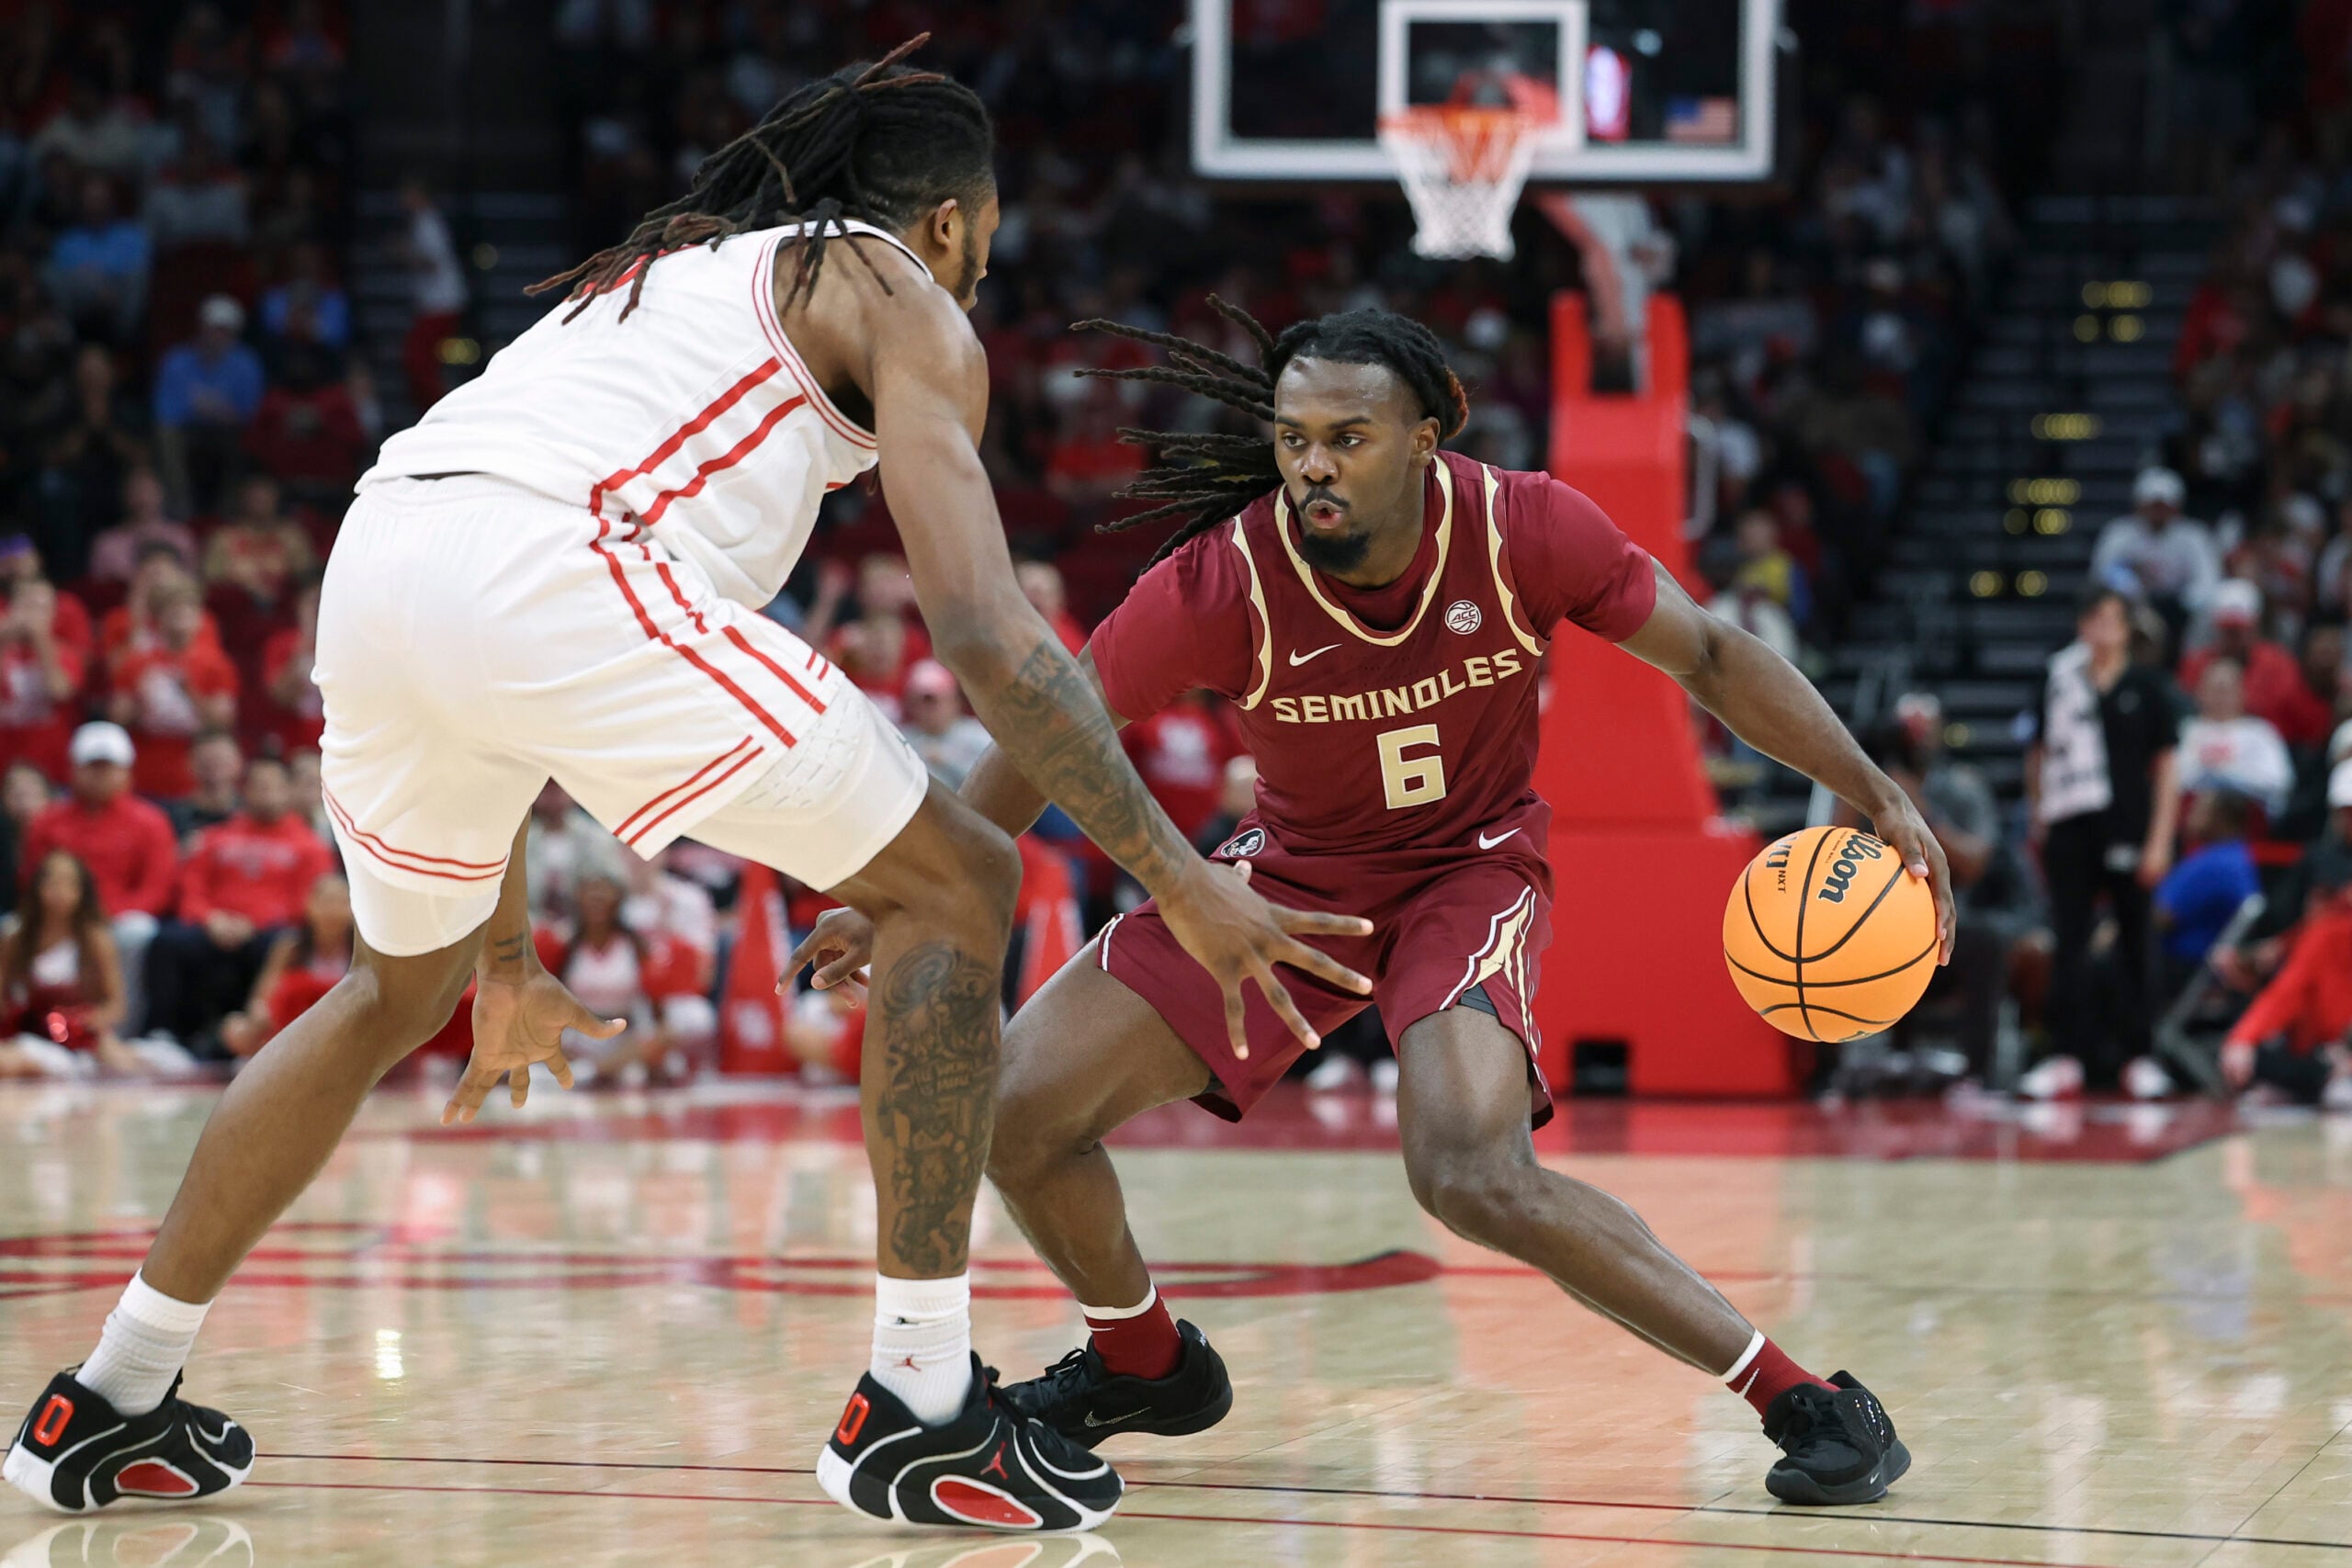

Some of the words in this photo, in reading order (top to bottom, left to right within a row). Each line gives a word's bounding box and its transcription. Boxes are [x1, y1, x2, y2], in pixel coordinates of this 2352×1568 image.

[1452, 608, 1476, 622] ACC
[1270, 649, 1522, 723] SEMINOLES
[1376, 724, 1446, 810] 6
[1777, 870, 1786, 894] NXT
